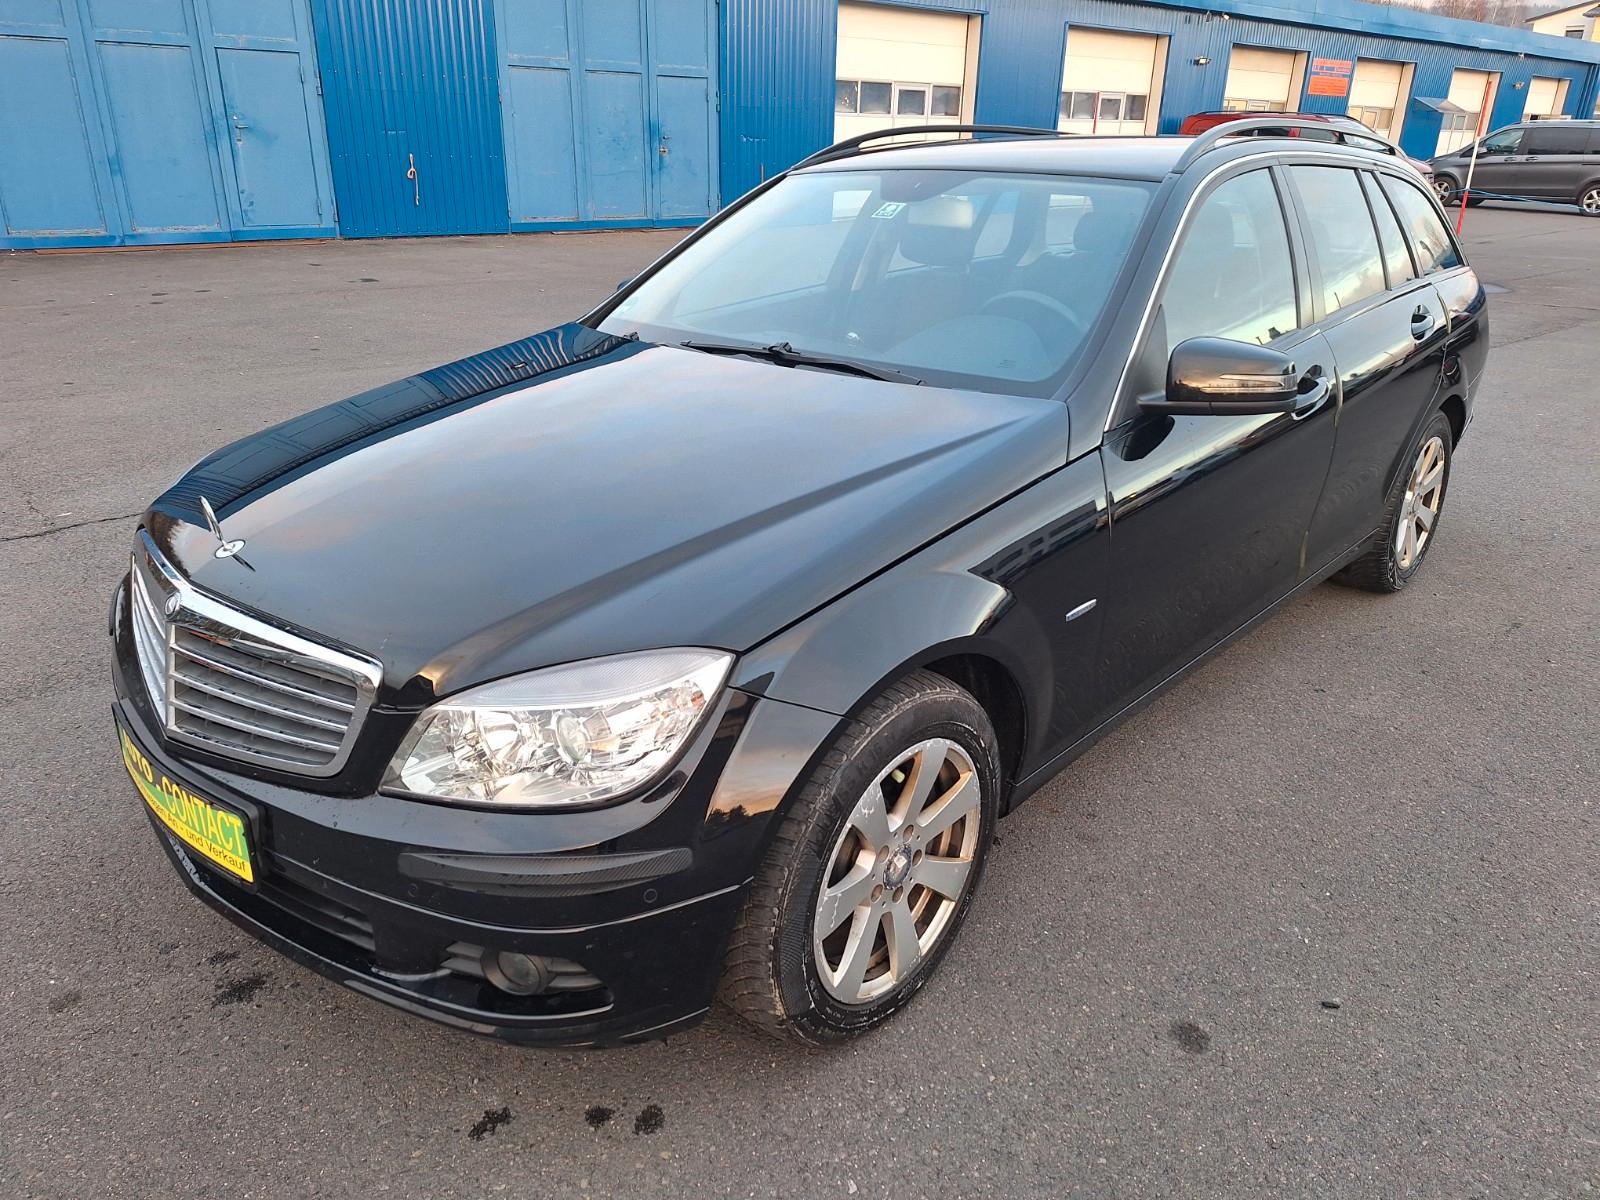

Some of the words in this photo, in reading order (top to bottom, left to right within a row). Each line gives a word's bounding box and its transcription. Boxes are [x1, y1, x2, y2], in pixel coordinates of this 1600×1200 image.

[161, 776, 243, 857] CONTACT
[186, 830, 204, 847] und
[206, 841, 246, 873] Verkauf
